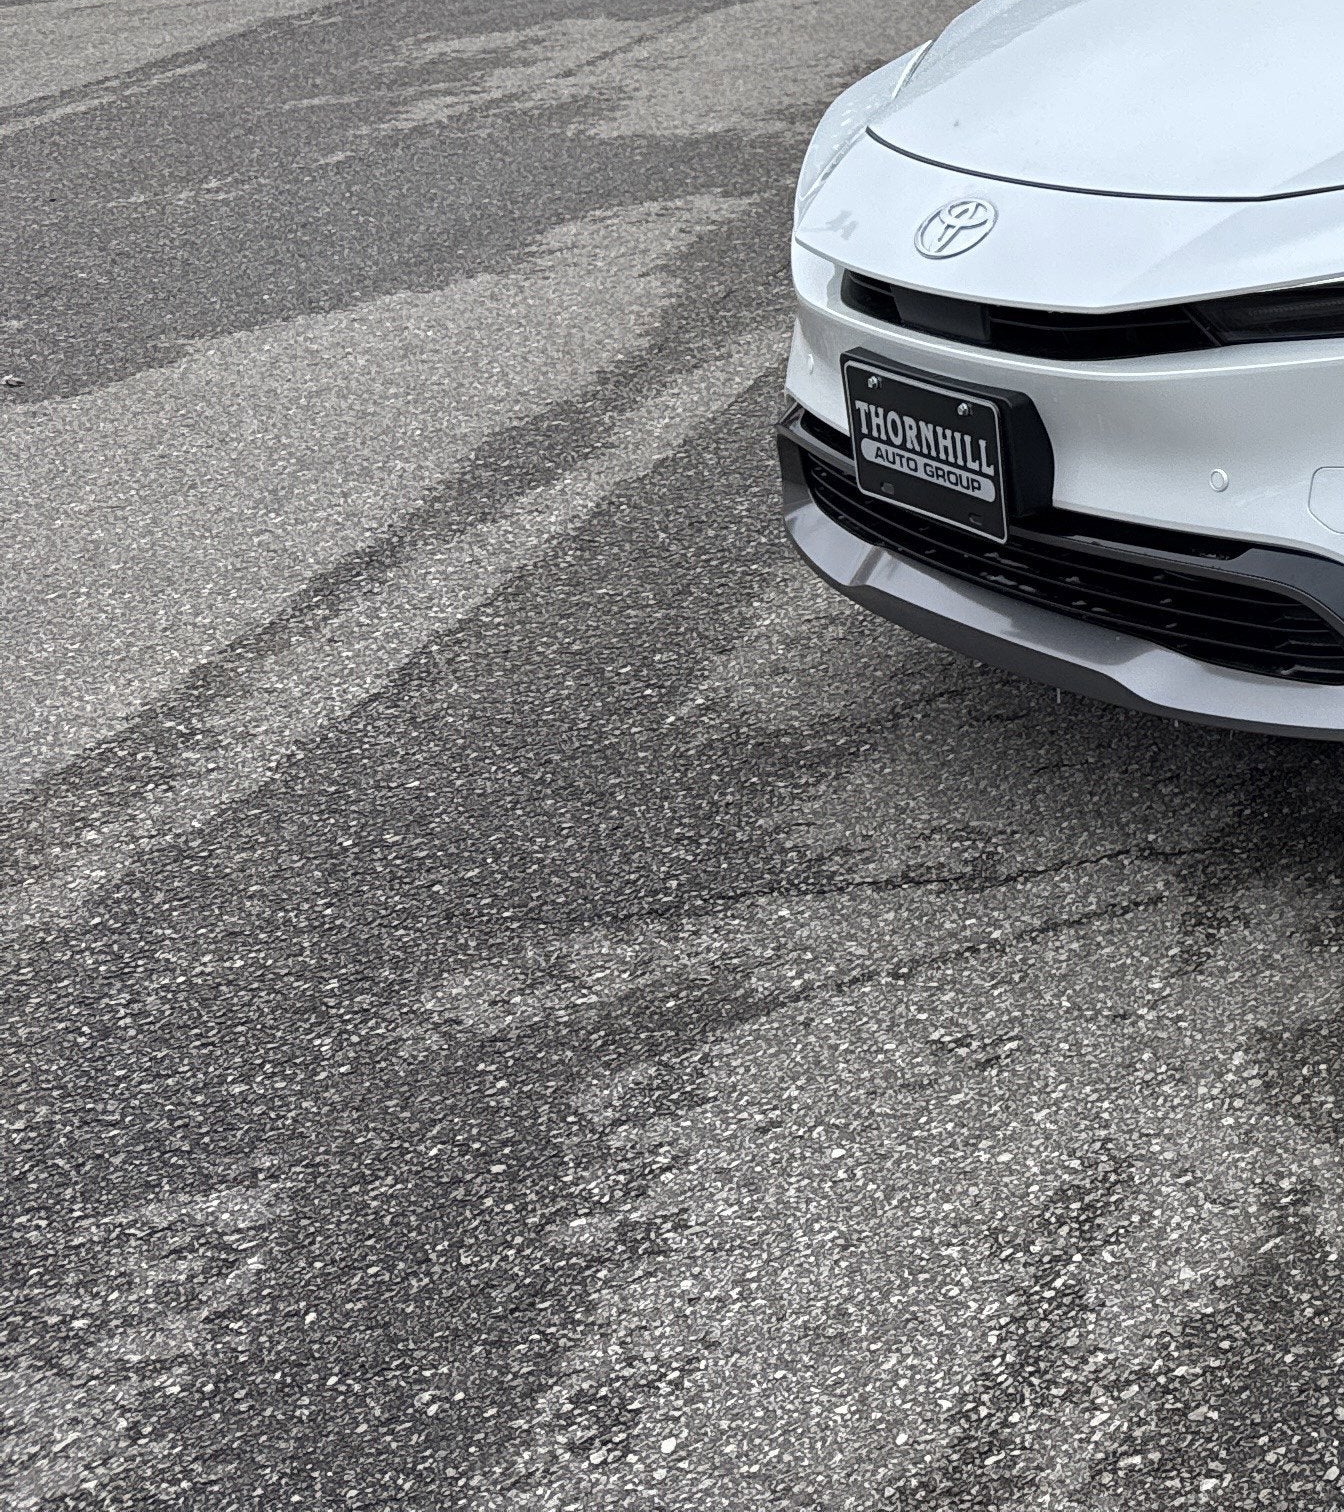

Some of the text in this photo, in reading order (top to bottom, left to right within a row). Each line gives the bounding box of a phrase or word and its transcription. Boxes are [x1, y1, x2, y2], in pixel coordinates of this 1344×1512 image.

[854, 399, 995, 477] THORNHILL
[874, 446, 981, 493] AUTO GROUP
